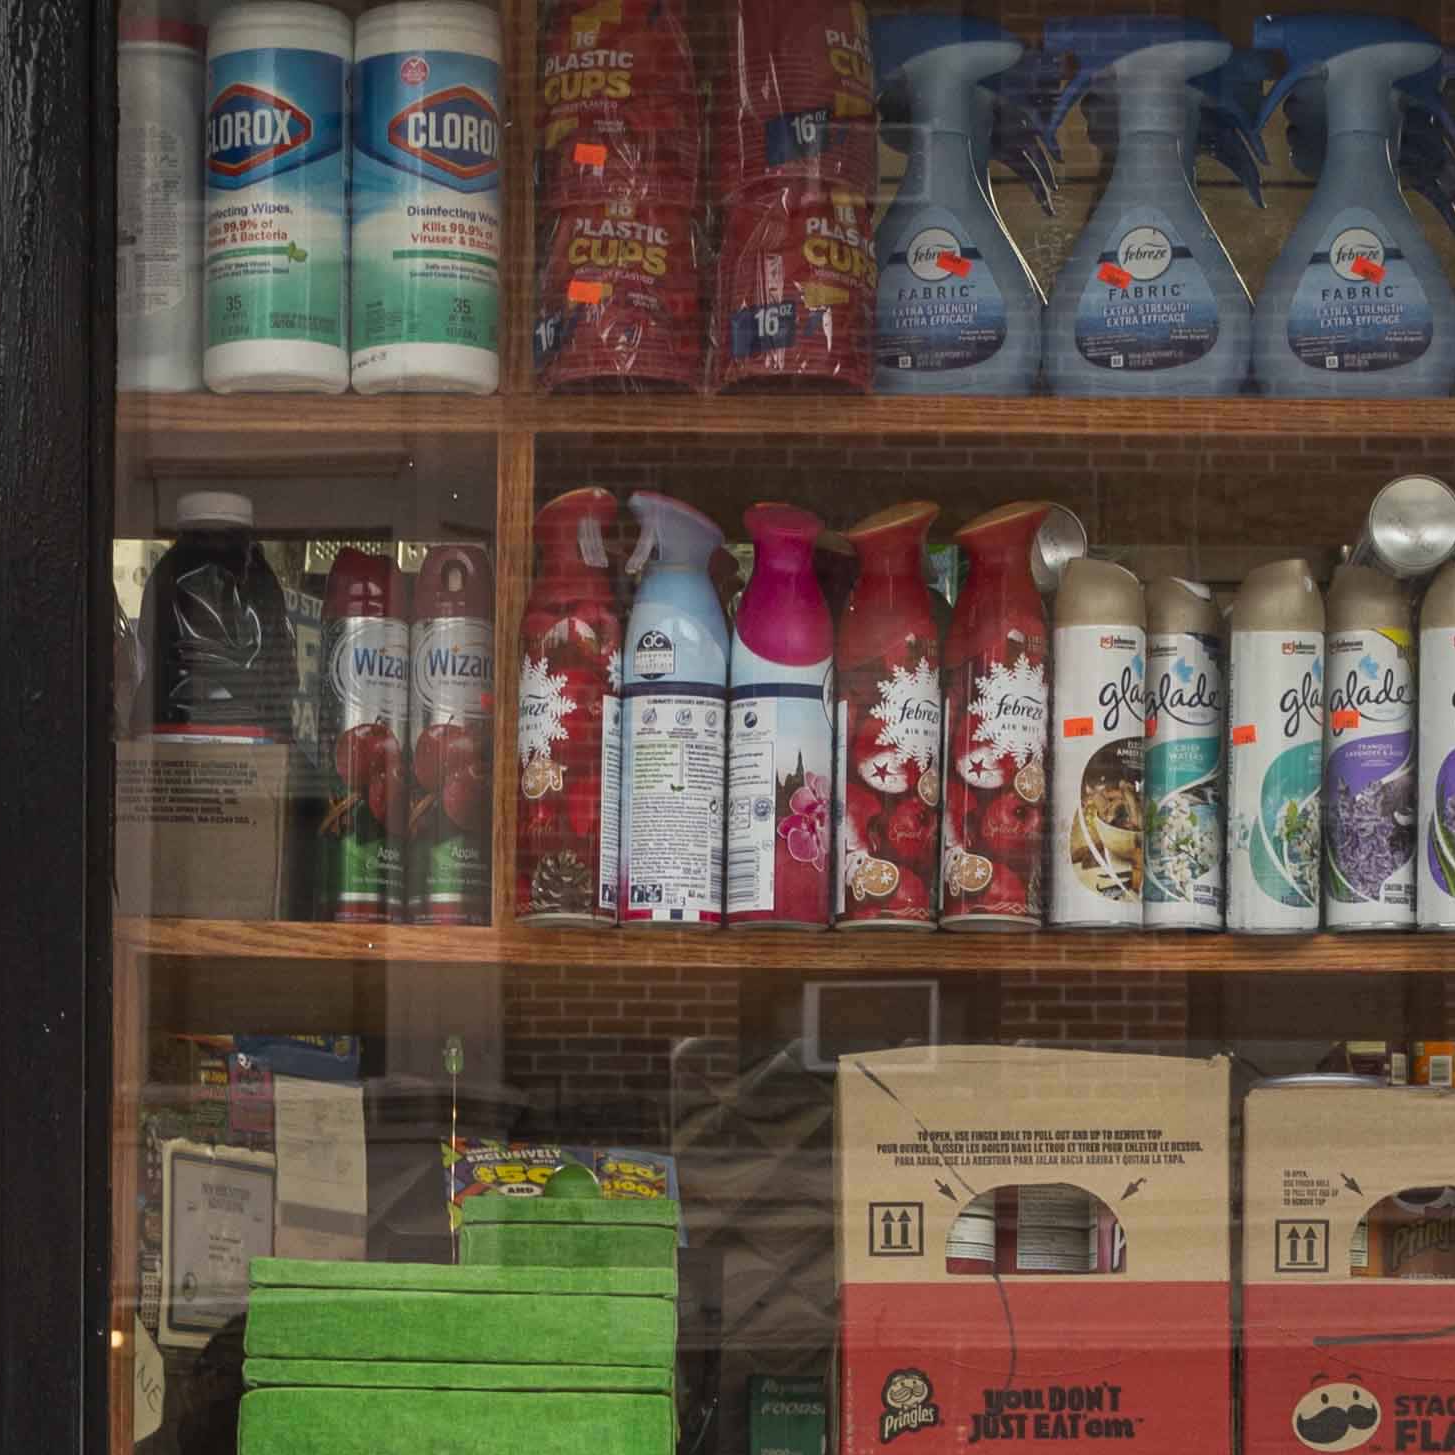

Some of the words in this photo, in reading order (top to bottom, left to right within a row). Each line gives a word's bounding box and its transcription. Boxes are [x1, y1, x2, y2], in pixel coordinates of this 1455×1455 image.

[545, 50, 634, 74] PLASTIC
[545, 71, 631, 100] CUPS
[790, 113, 818, 144] 16
[407, 204, 477, 223] Disinfecting
[240, 231, 288, 243] Bacteria
[422, 223, 448, 235] Kills
[450, 224, 484, 240] 99.9%
[568, 238, 668, 276] CUPS
[1121, 243, 1168, 268] febreze
[897, 286, 970, 300] FABRIC
[1108, 284, 1183, 301] FABRIC
[1321, 285, 1394, 302] FABRIC
[225, 296, 243, 312] 35
[452, 296, 471, 314] 35
[1103, 304, 1134, 317] EXTRA
[1136, 303, 1190, 316] STRENGTH
[1315, 304, 1348, 317] EXTRA
[1352, 303, 1404, 317] STRENGTH
[754, 307, 779, 338] 16
[1106, 315, 1138, 328] EXTRA
[1140, 313, 1186, 326] EFFICACE
[1320, 316, 1353, 329] EXTRA
[1354, 314, 1401, 327] EFFICACE
[1329, 668, 1413, 737] glade
[1001, 722, 1017, 732] AIR
[466, 1148, 562, 1163] EXCLUSIVELY
[507, 1186, 534, 1195] AND
[982, 1389, 1044, 1421] you
[1047, 1384, 1122, 1414] DON'T
[882, 1405, 936, 1439] Pringles
[968, 1415, 1029, 1444] JUST
